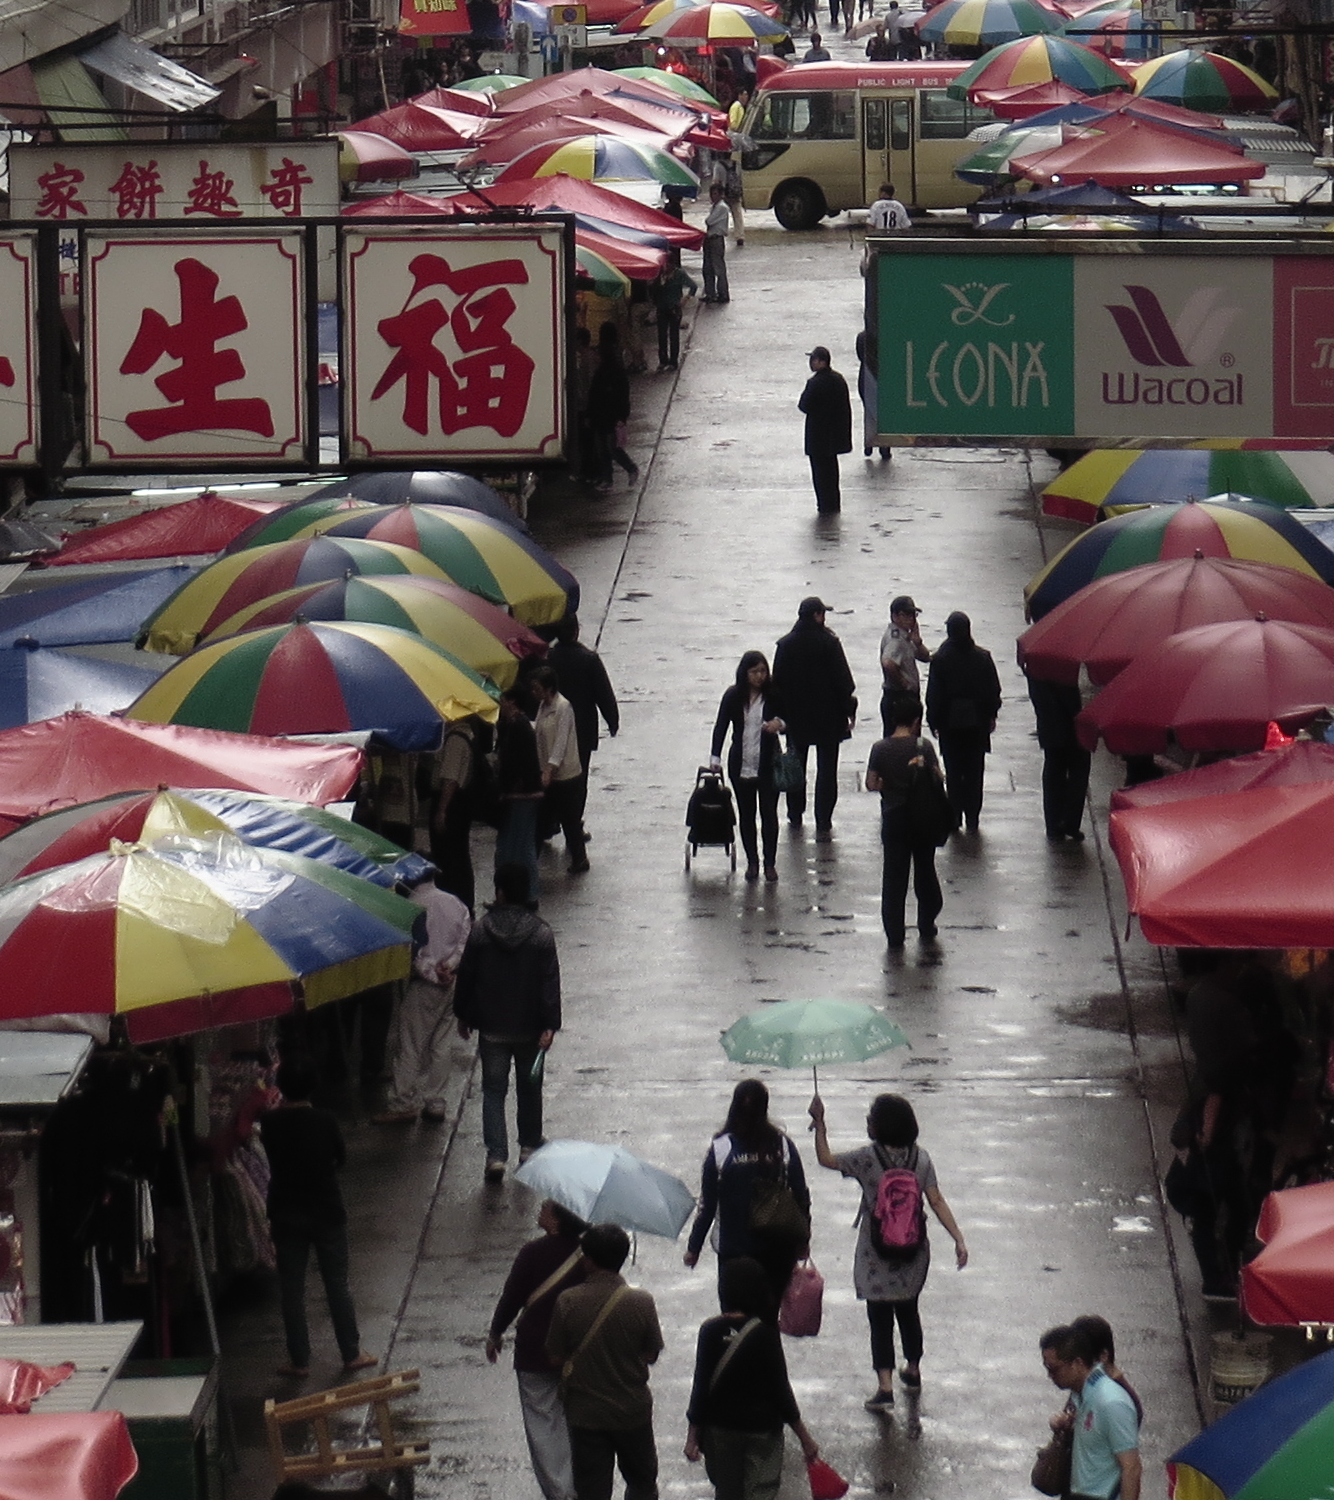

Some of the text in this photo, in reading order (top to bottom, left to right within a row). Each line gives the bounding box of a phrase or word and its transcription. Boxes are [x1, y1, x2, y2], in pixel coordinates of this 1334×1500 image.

[857, 78, 886, 87] PUBLIC
[892, 78, 915, 86] LIGHT
[922, 78, 939, 86] BUS
[882, 210, 897, 228] 18
[905, 340, 1050, 409] LEONA
[1101, 370, 1244, 406] Wacoal
